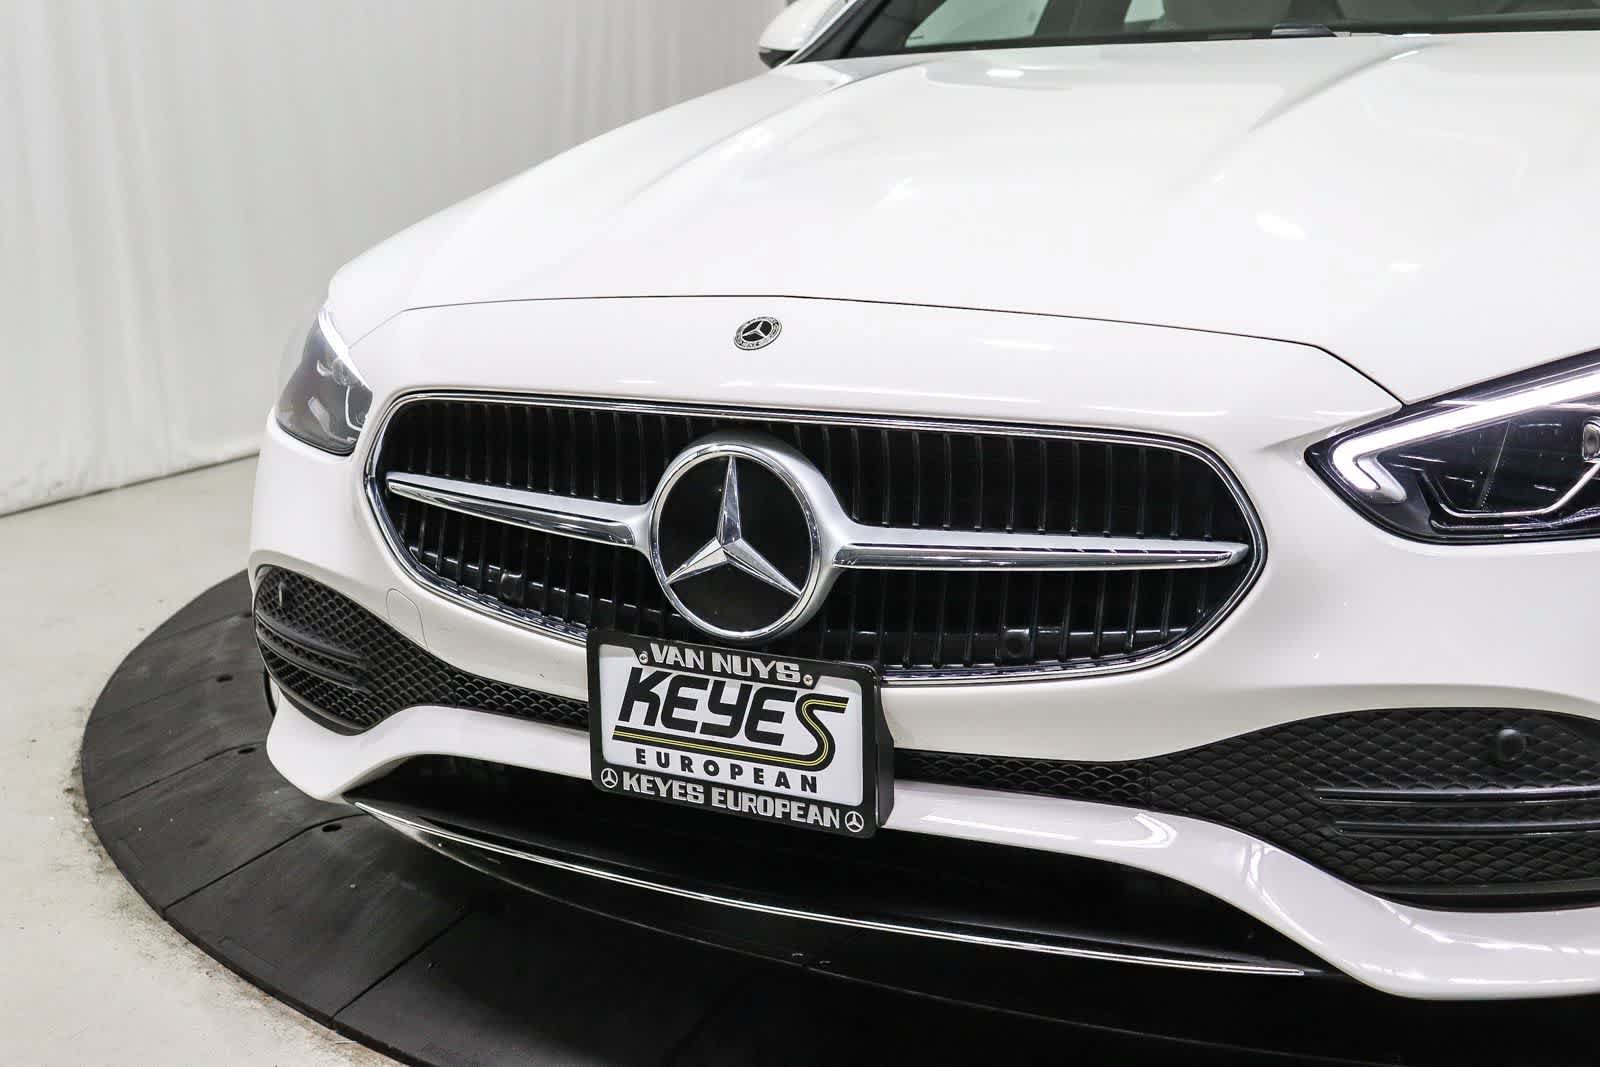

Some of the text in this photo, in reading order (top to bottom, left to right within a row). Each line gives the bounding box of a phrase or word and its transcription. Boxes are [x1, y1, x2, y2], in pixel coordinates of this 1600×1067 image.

[650, 643, 800, 683] VAN NUYS
[617, 666, 850, 771] KEYES
[635, 748, 817, 793] EUROPEAN
[622, 771, 840, 828] KEYES EUROPEAN
